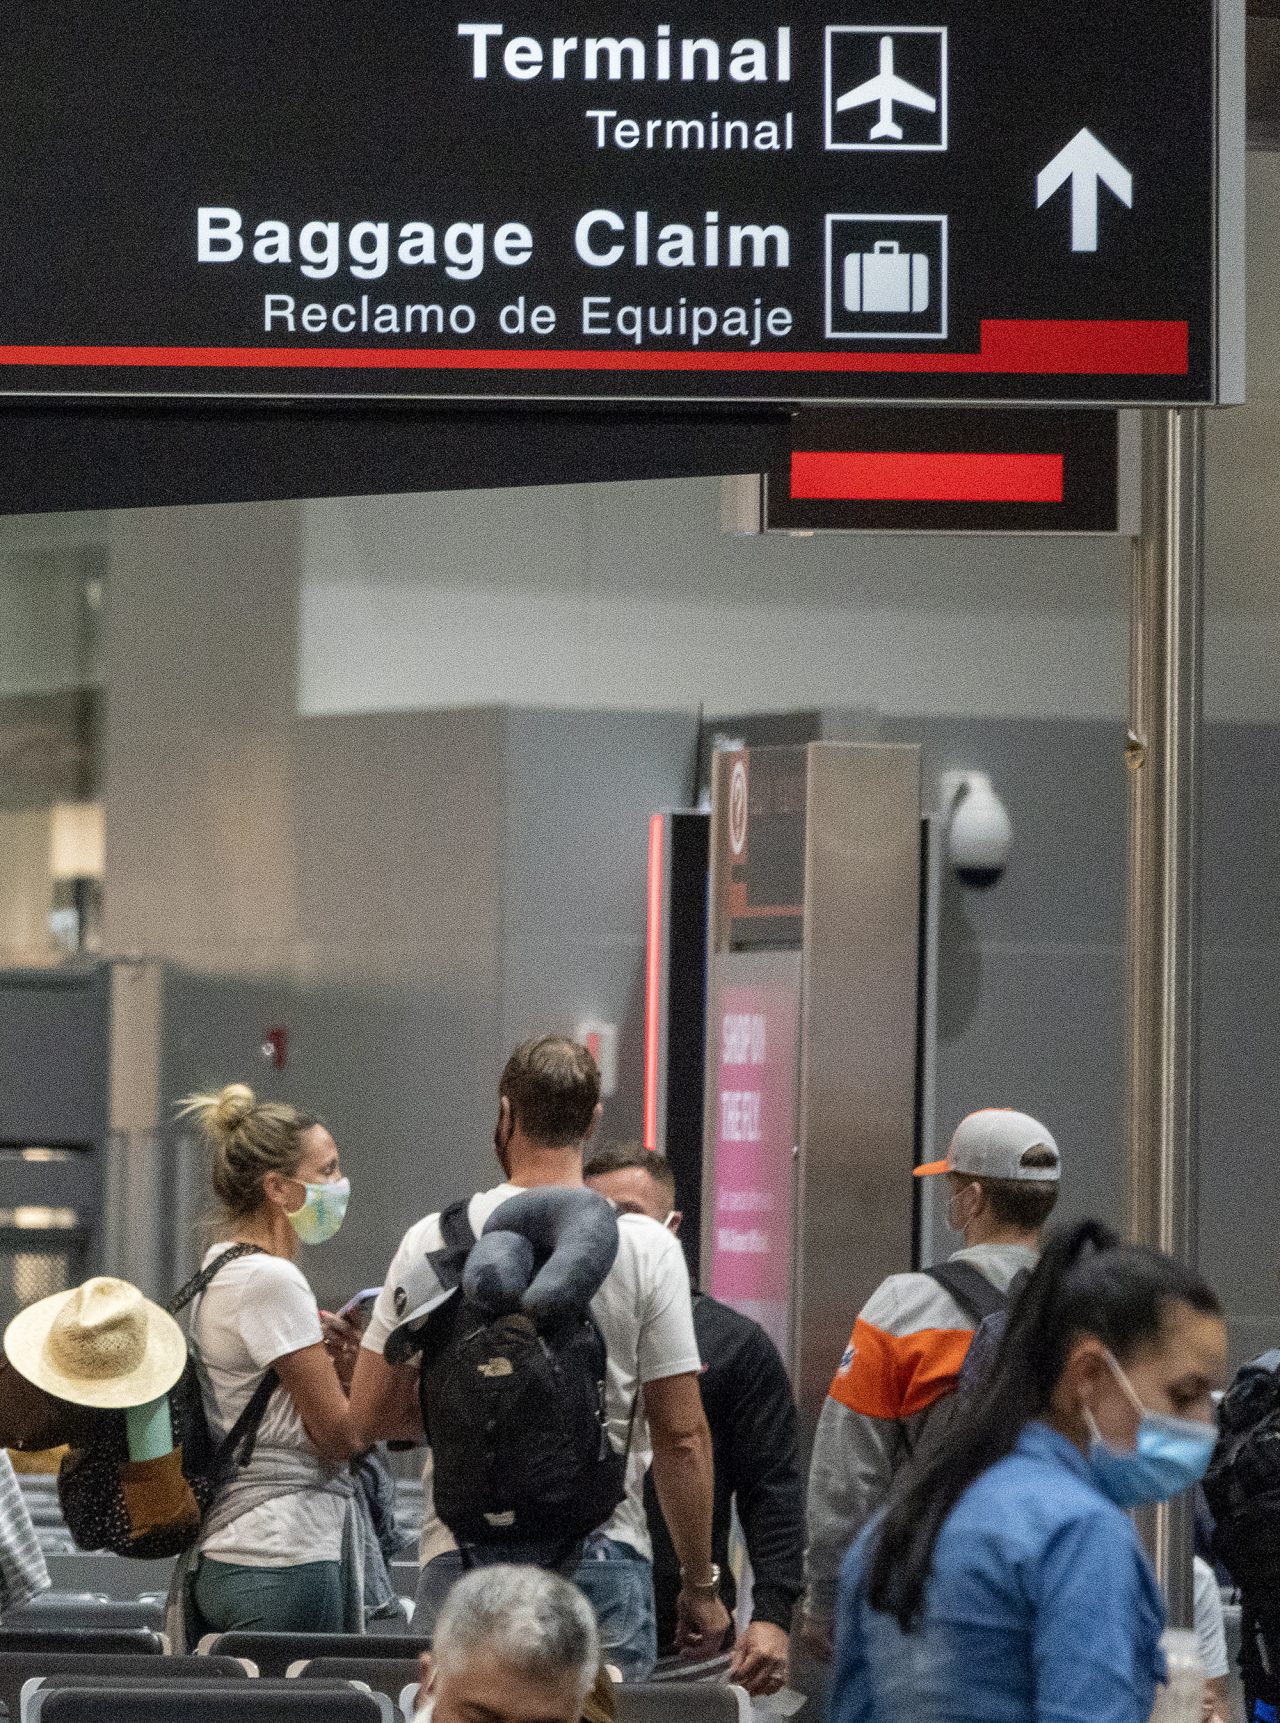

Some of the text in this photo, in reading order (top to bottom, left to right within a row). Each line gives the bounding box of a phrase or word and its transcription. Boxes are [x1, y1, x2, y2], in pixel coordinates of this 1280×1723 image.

[458, 22, 791, 83] Terminal
[586, 110, 794, 151] Terminal
[196, 206, 791, 281] Baggage Claim
[264, 293, 793, 346] Reclamo de Equipaje
